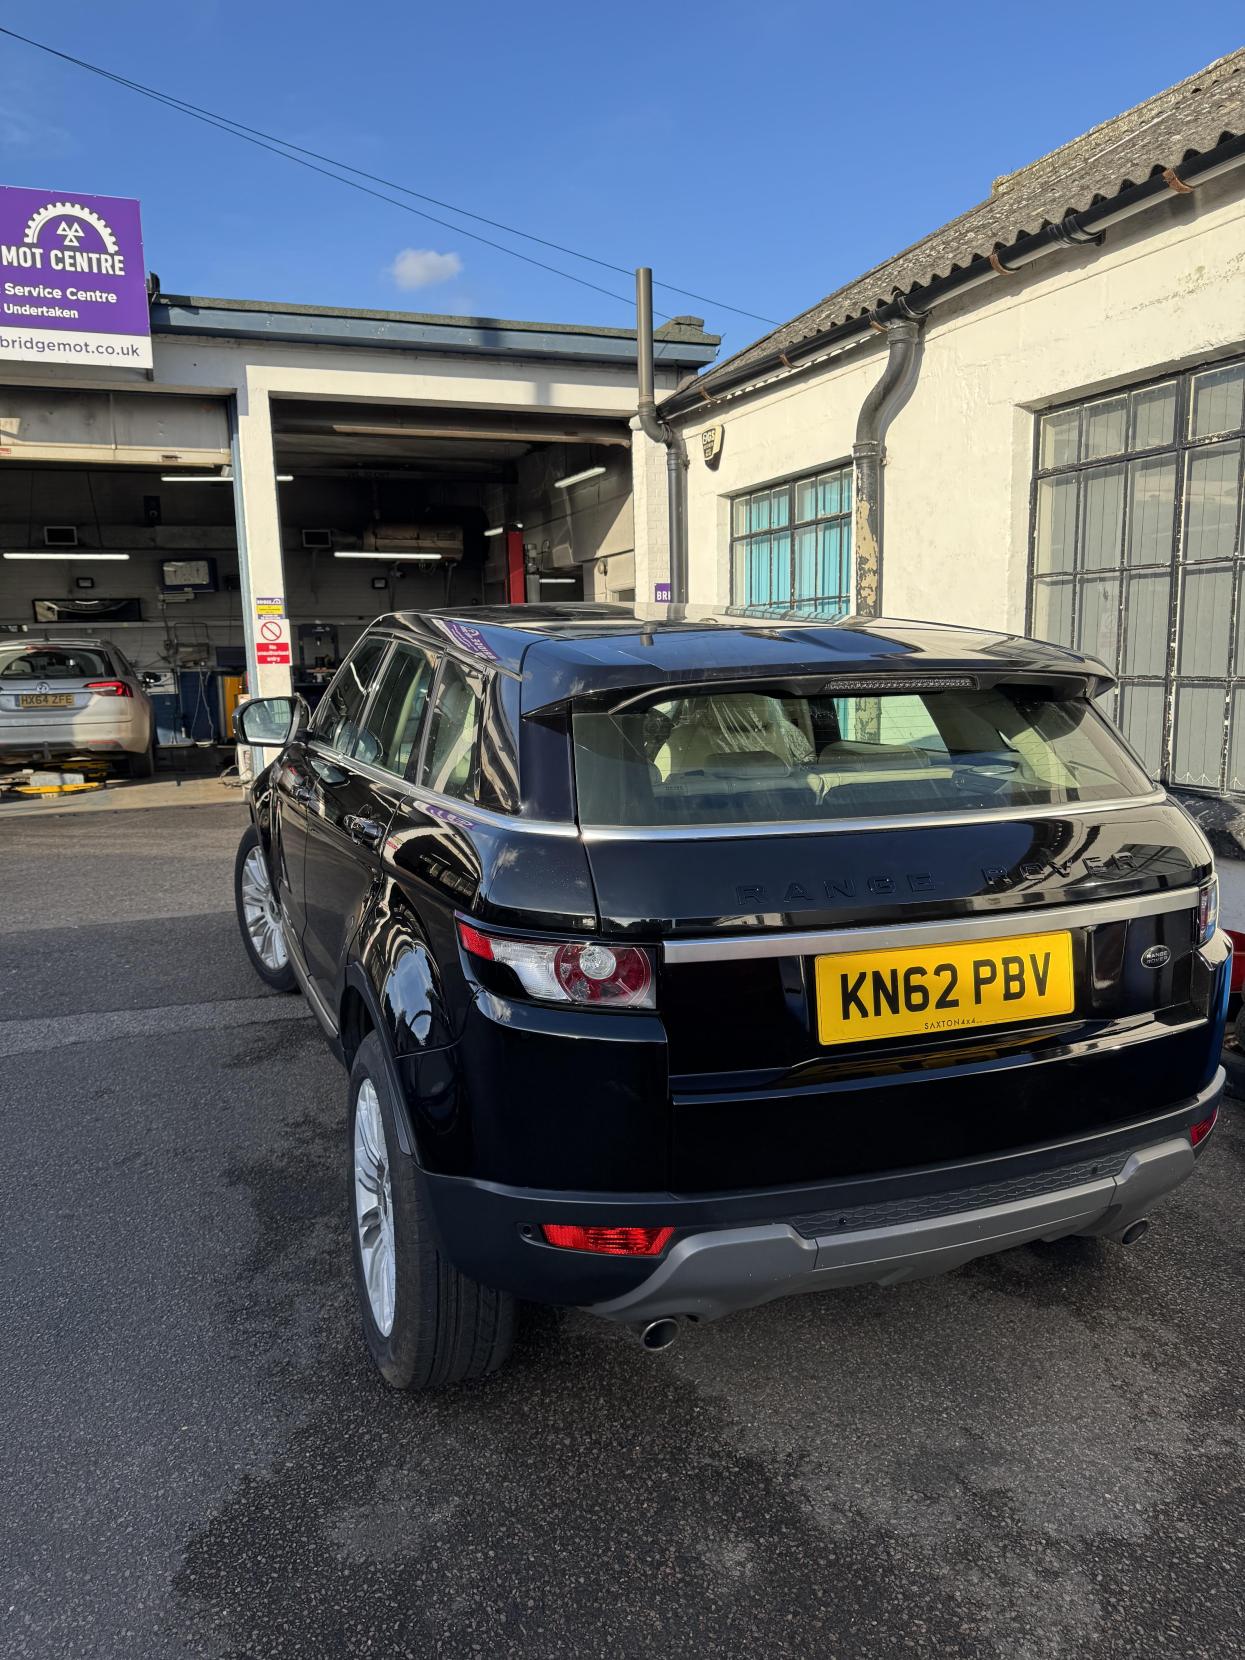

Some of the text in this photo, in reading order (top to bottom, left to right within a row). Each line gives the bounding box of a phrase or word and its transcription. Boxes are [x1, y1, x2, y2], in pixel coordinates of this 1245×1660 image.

[1, 245, 125, 276] MOT CENTRE
[4, 282, 117, 303] Service Centre
[4, 303, 79, 319] Undertaken
[0, 335, 140, 357] bridgemot.co.uk
[21, 694, 73, 705] HX64 ZFE
[736, 852, 1138, 905] RANGE ROVER
[1146, 951, 1168, 959] RANGE
[1147, 955, 1168, 964] ROVER
[840, 952, 1051, 1021] KN62 PBV
